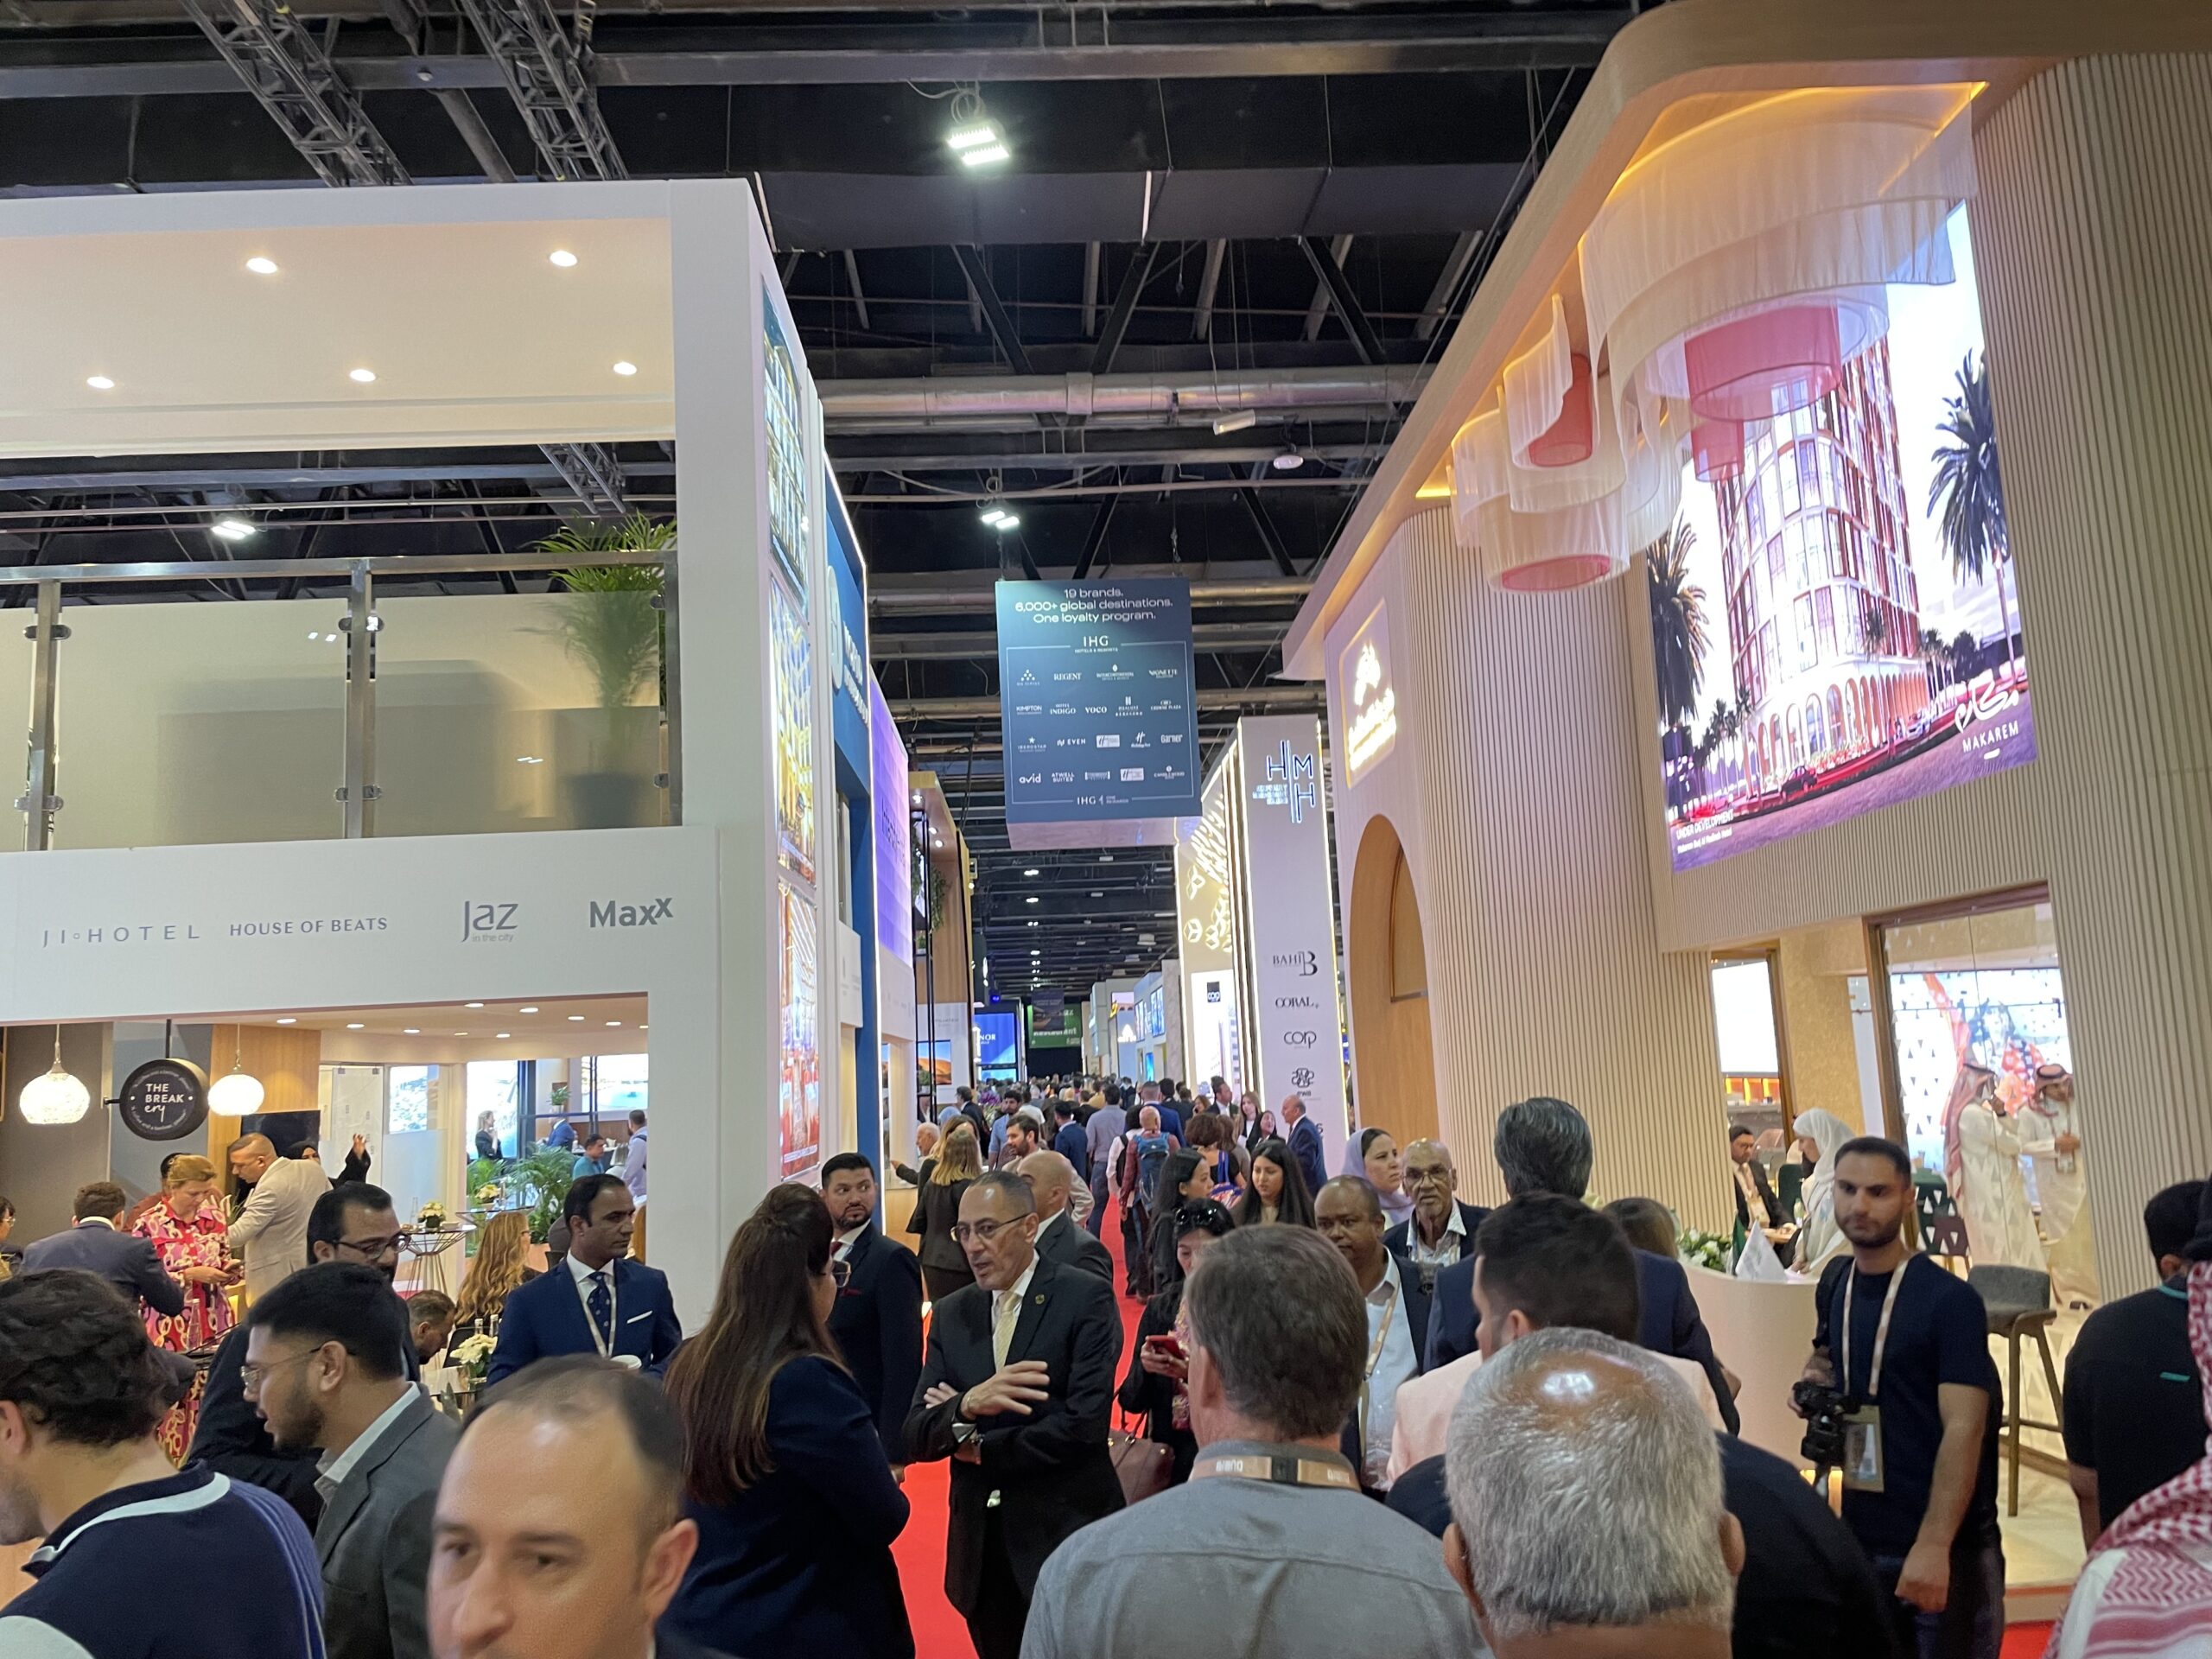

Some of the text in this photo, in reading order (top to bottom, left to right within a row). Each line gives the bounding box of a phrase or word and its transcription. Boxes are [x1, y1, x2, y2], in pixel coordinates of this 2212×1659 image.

[1064, 588, 1123, 599] 19 brands.
[1014, 597, 1173, 613] 6,000+ global destinations.
[1033, 610, 1156, 625] One loyalty program.
[1083, 635, 1109, 647] IHG
[1053, 672, 1082, 681] REGENT
[1160, 734, 1183, 744] Garner
[1962, 720, 2018, 753] MAKAREM
[1019, 772, 1042, 785] avid
[1077, 796, 1096, 805] IHG
[1676, 808, 1734, 841] UNDER DEVELOPMENT
[589, 897, 674, 929] Maxx
[229, 917, 388, 937] HOUSE OF BEATS
[461, 900, 518, 943] Jaz
[472, 933, 514, 943] in the city
[1274, 995, 1314, 1008] CORAL
[145, 1083, 169, 1093] THE
[144, 1094, 185, 1103] BREAK
[144, 1104, 166, 1122] ery
